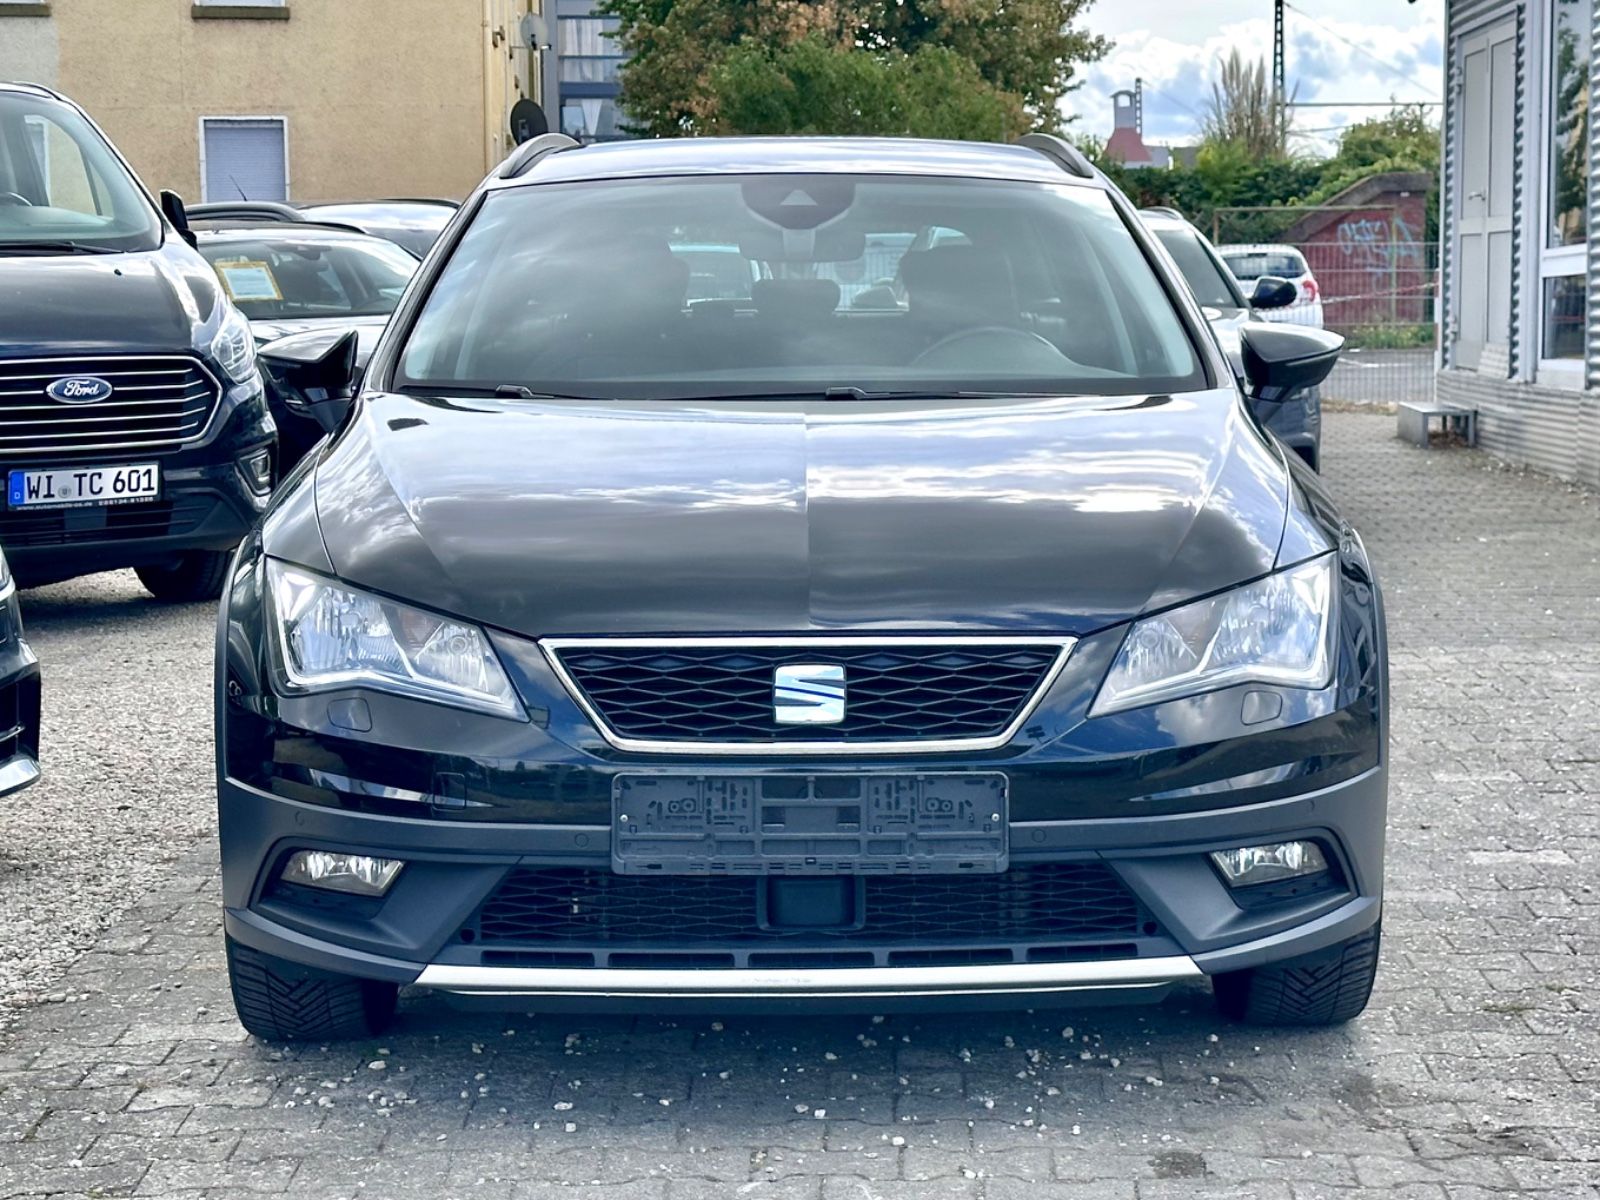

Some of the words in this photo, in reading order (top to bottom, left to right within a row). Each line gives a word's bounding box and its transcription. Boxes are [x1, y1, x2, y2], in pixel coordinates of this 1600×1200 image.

[64, 380, 100, 397] Ford
[27, 475, 55, 500] WI
[73, 472, 104, 497] TC
[113, 468, 155, 494] 601
